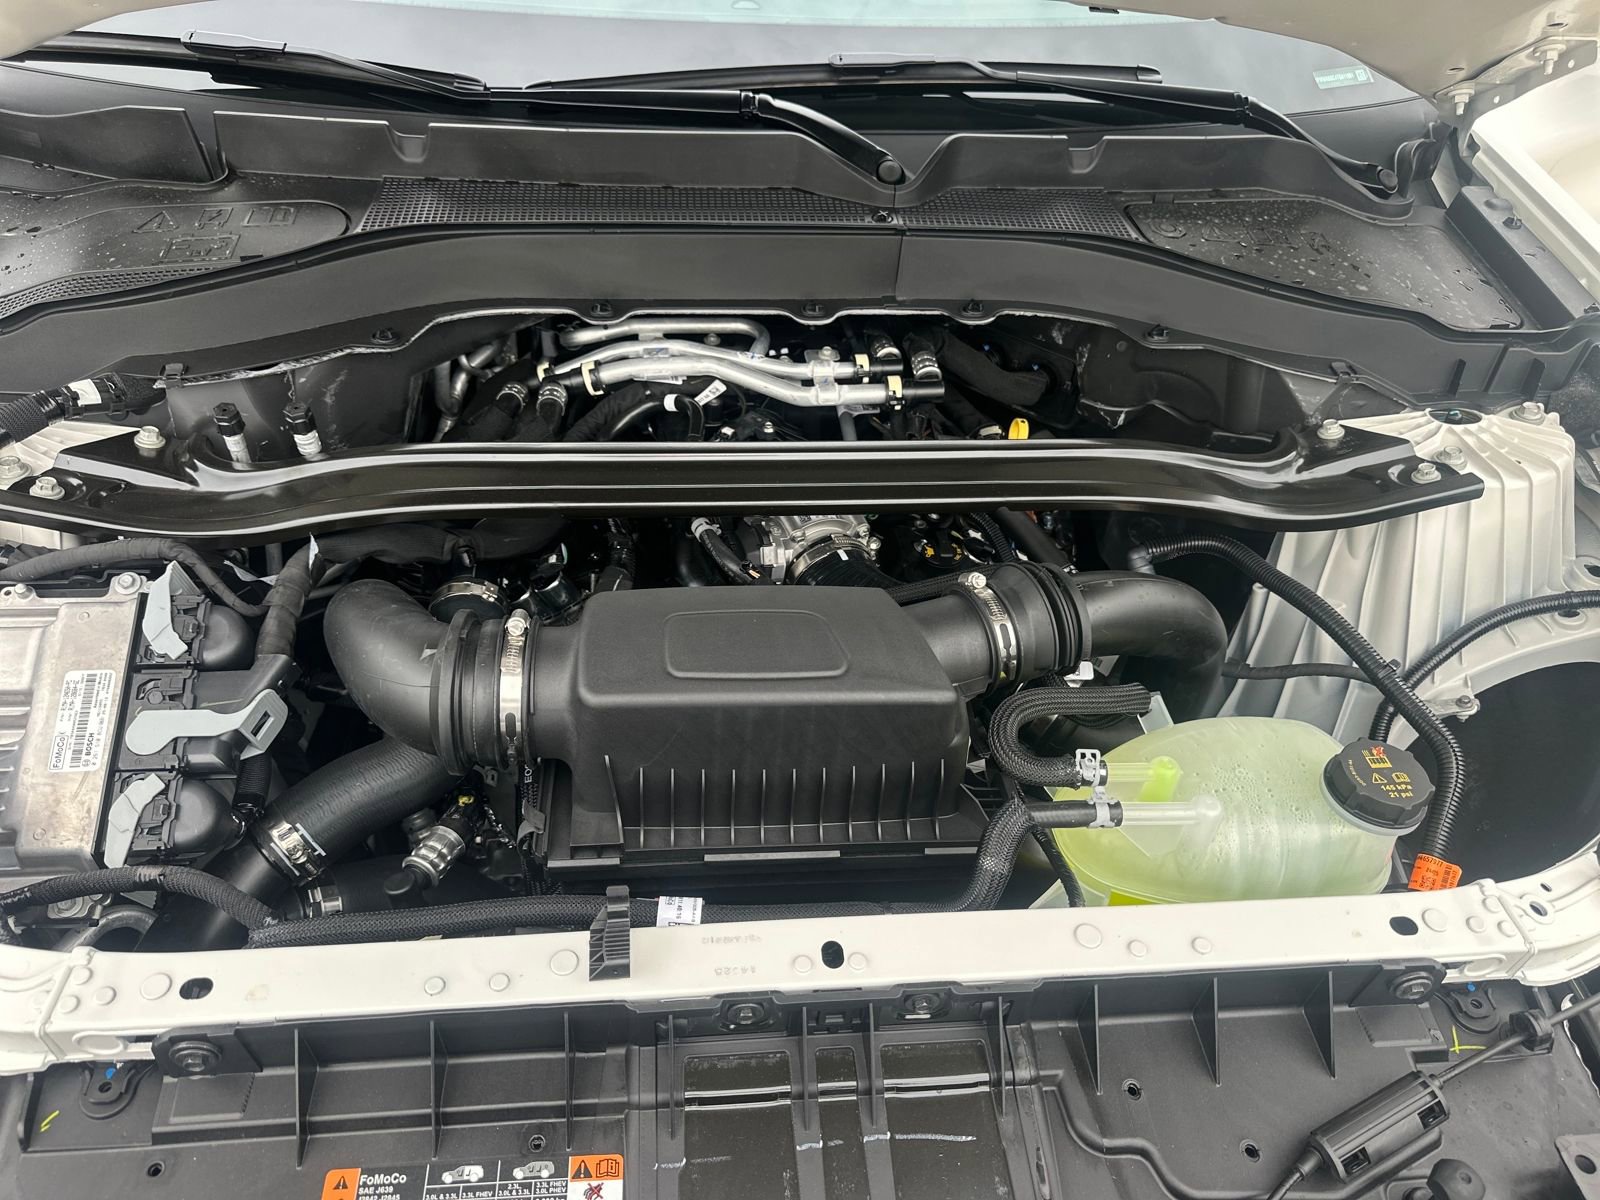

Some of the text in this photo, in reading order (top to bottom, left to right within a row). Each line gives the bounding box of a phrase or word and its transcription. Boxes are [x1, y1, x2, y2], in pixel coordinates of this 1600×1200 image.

[53, 736, 66, 768] FoMoCo
[84, 732, 95, 756] BOSCH
[360, 1173, 407, 1186] FoMoCo
[358, 1186, 394, 1195] SAE J639
